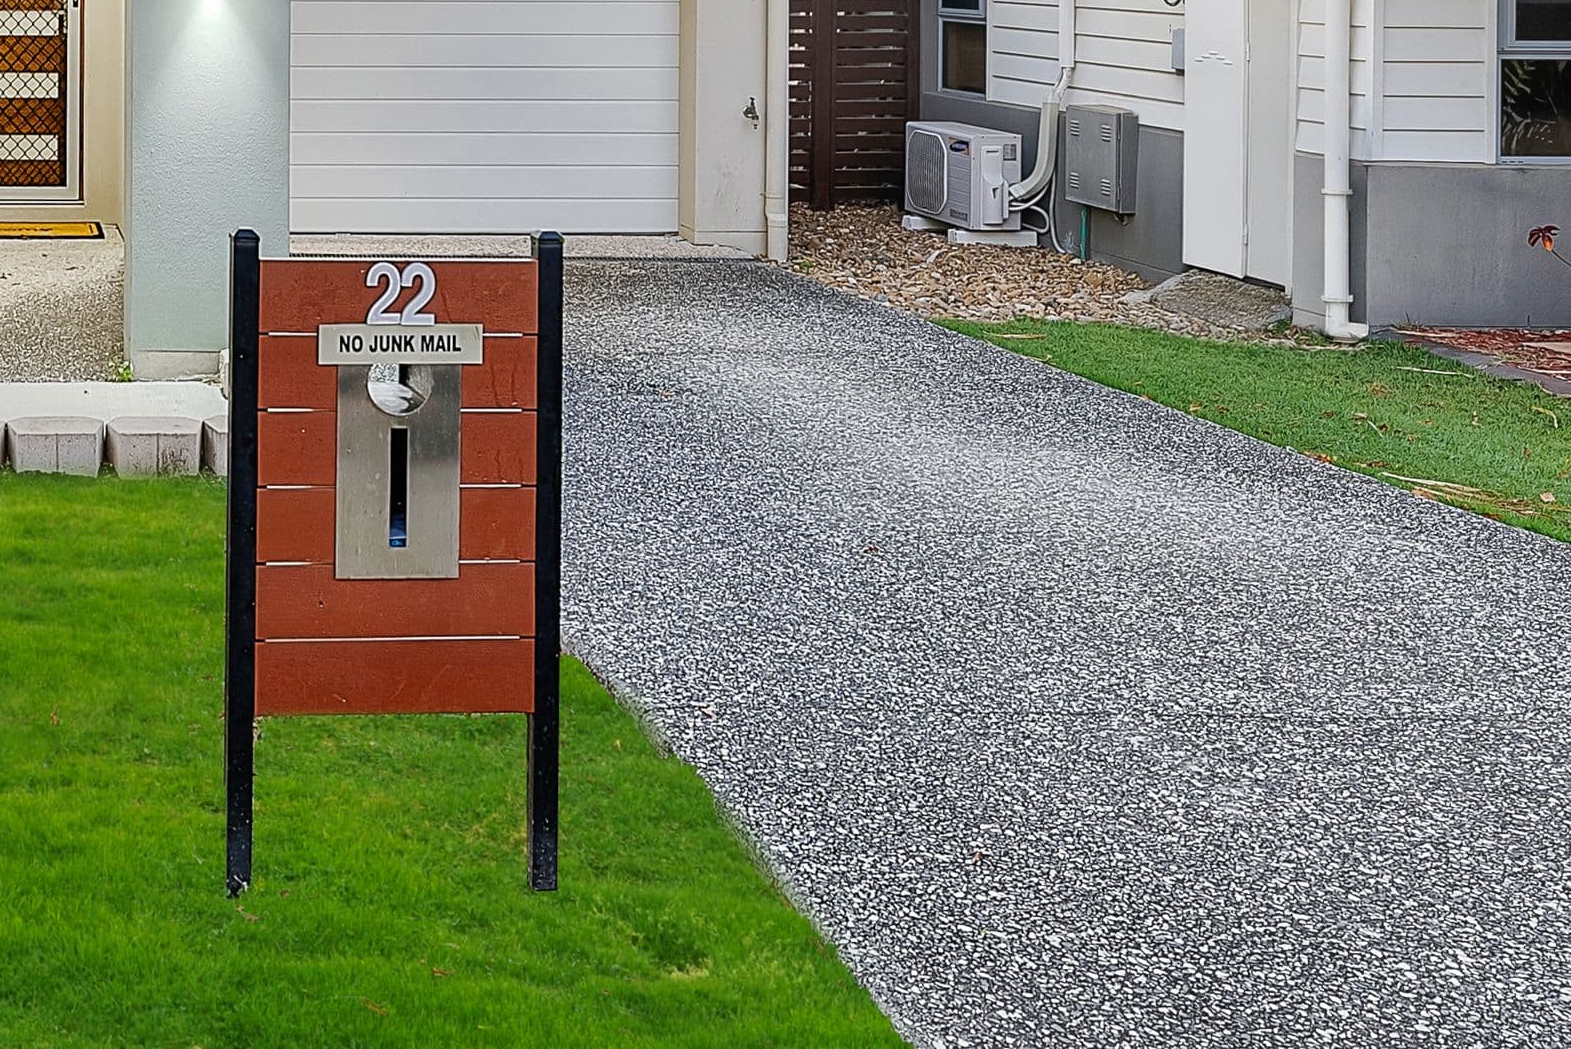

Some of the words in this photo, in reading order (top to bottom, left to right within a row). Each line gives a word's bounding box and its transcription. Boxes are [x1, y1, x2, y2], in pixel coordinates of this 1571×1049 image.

[366, 261, 436, 326] 22
[339, 335, 364, 353] NO
[369, 335, 415, 353] JUNK
[421, 335, 462, 352] MAIL
